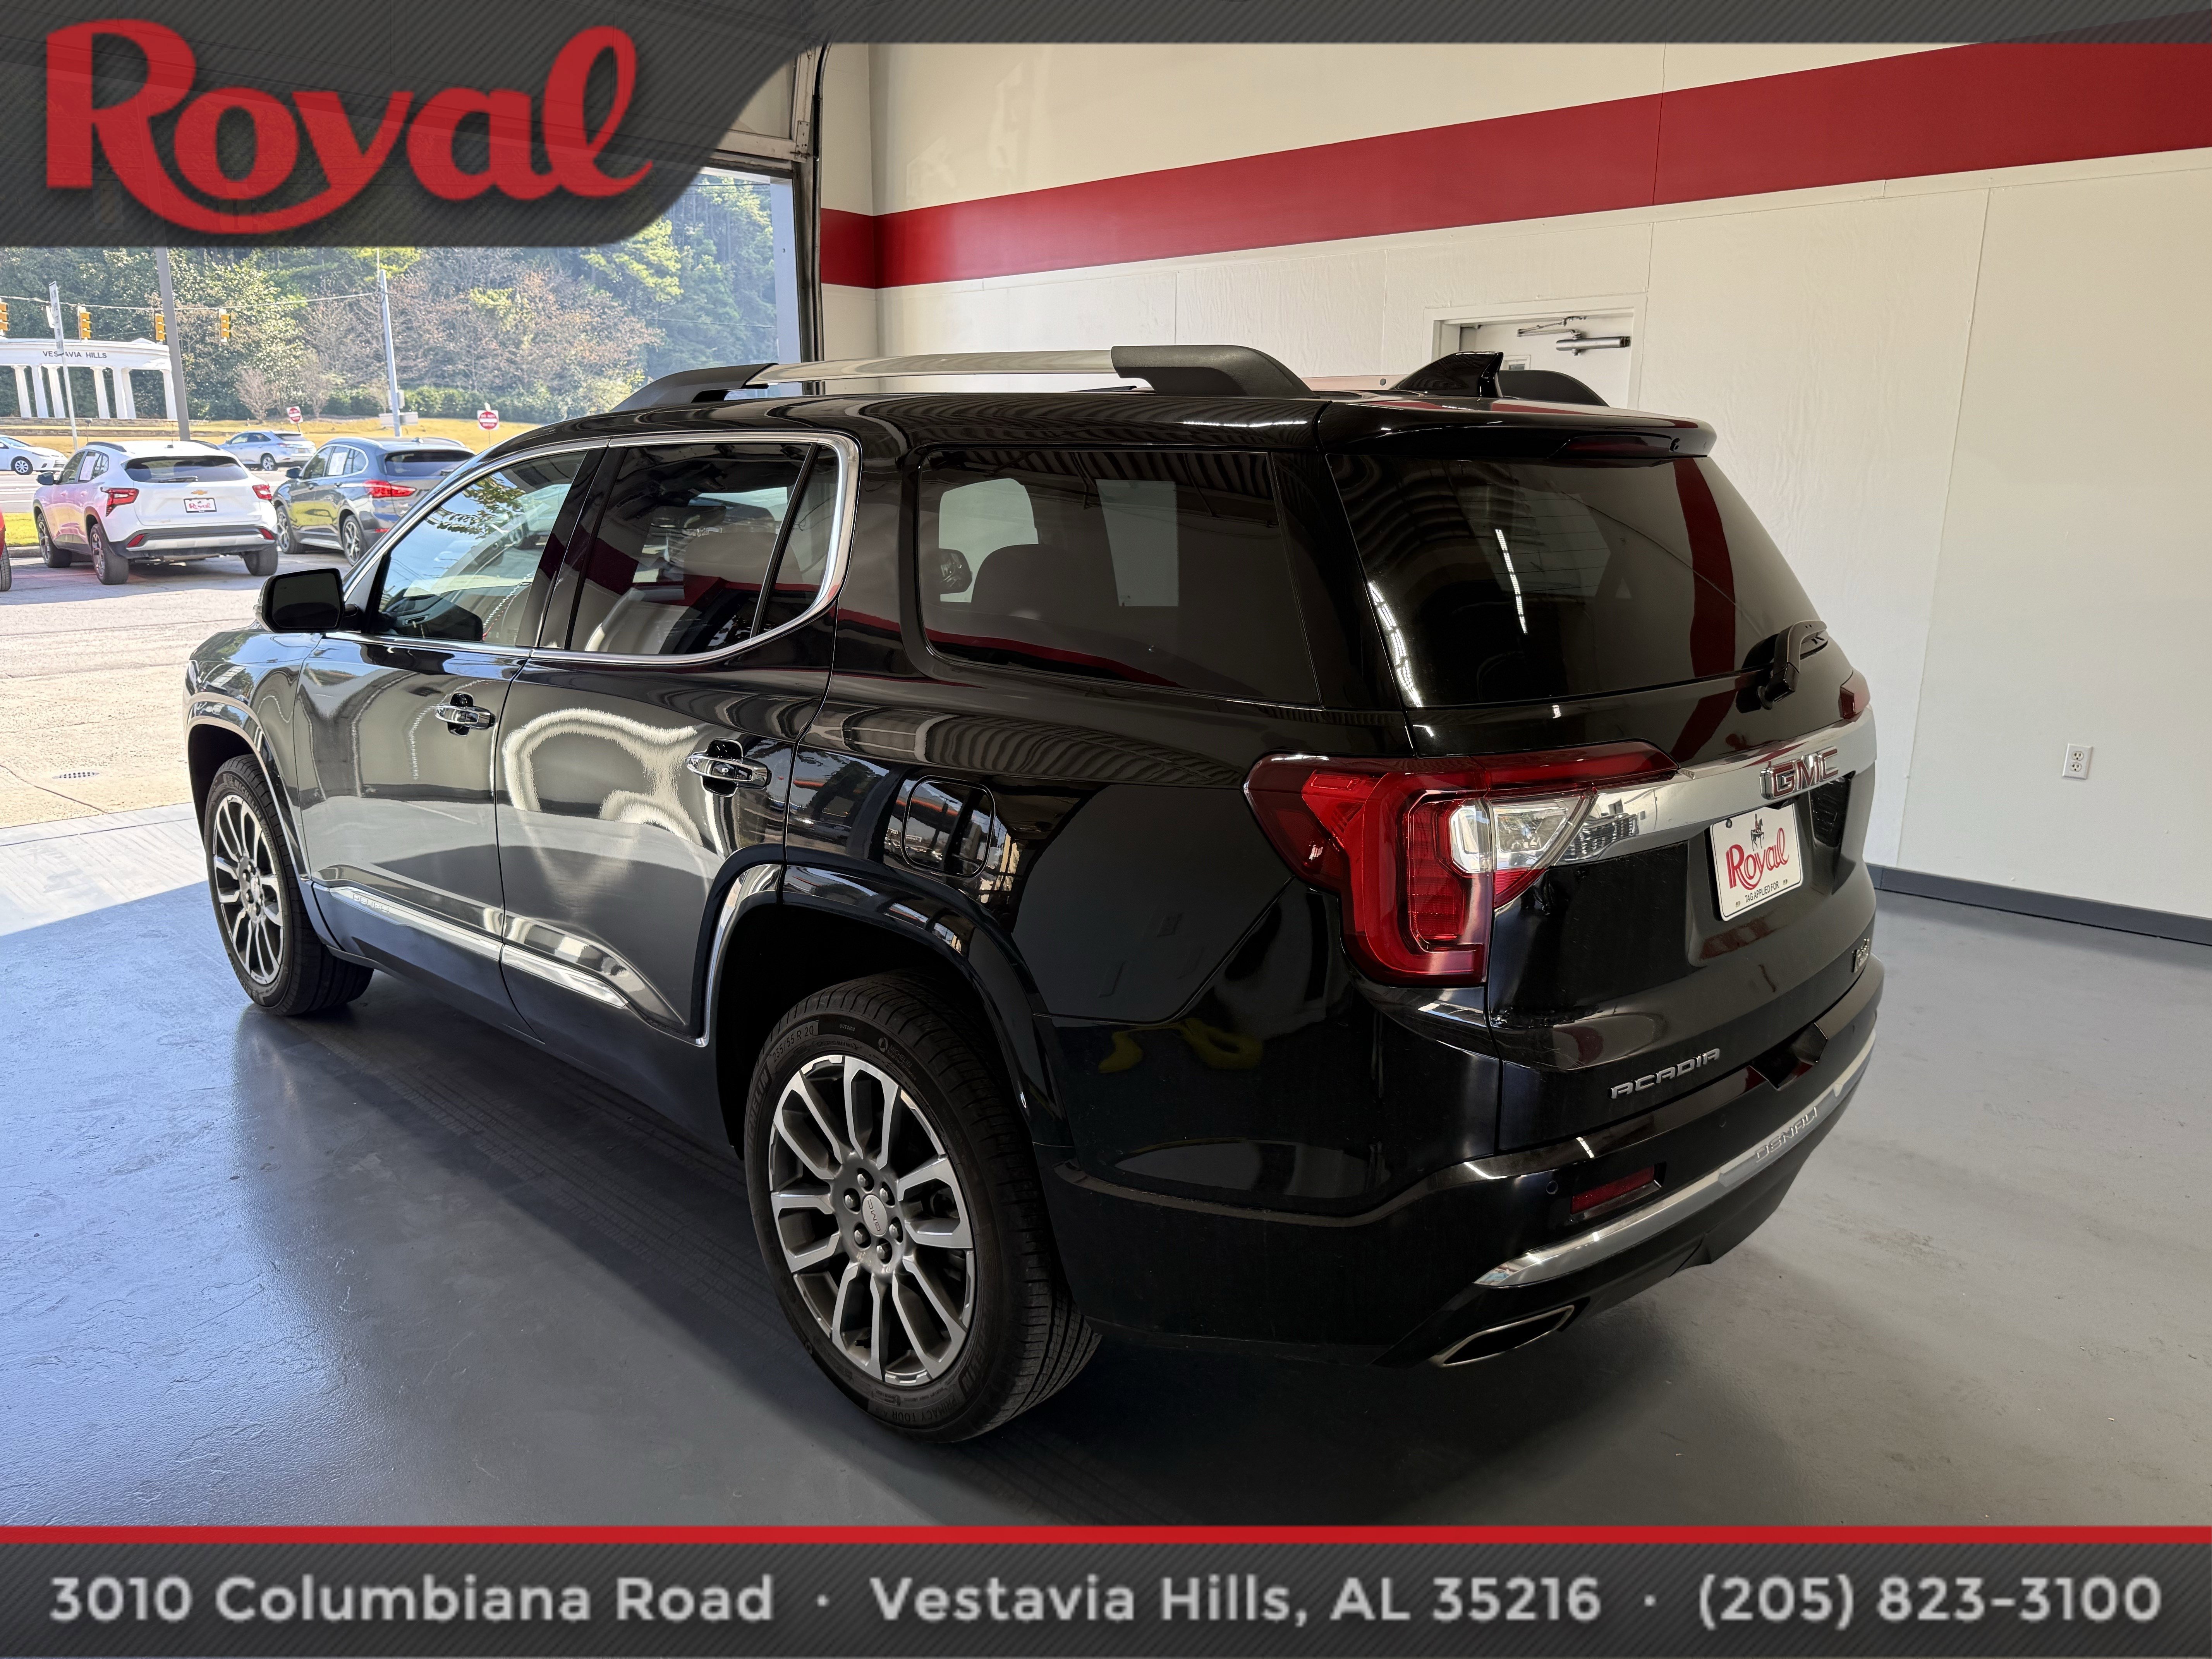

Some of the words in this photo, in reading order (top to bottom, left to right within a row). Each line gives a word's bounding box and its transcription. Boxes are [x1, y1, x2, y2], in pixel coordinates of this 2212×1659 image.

[1760, 746, 1838, 800] GMC
[234, 779, 261, 820] MICHELIN
[1726, 828, 1789, 890] Royal
[1745, 892, 1753, 903] TAG
[1754, 885, 1770, 900] APPLIED
[1771, 881, 1779, 891] FOR
[773, 1034, 794, 1063] 235/55
[797, 1030, 801, 1040] R
[805, 1025, 814, 1037] 20
[1610, 1048, 1720, 1099] ACADIA
[867, 1199, 881, 1231] GMC
[892, 1410, 916, 1422] TOUR
[921, 1396, 957, 1421] PRIMACY
